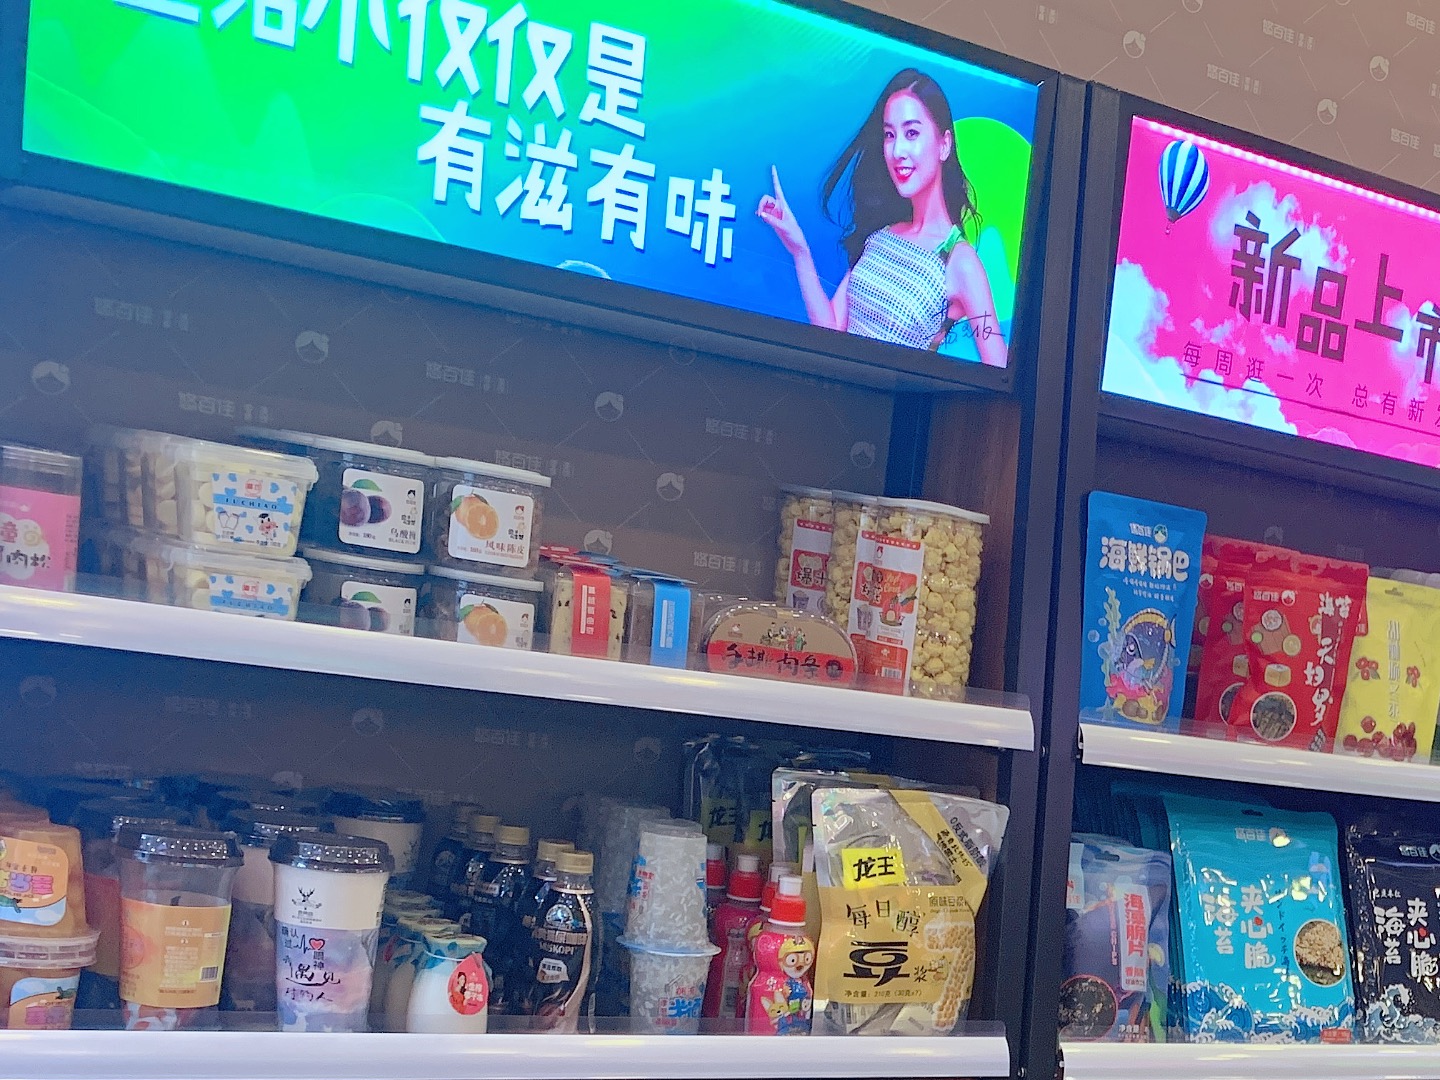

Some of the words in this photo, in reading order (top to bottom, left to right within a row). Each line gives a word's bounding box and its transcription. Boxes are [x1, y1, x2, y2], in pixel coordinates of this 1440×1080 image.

[416, 100, 737, 266] 有滋有味
[1182, 340, 1325, 400] 每周逛一次
[1099, 536, 1190, 582] 海鲜锅巴
[853, 856, 896, 882] 龙王
[1240, 884, 1276, 969] 夹心脆
[1374, 905, 1404, 965] 海苔
[1407, 897, 1438, 978] 夹心脆
